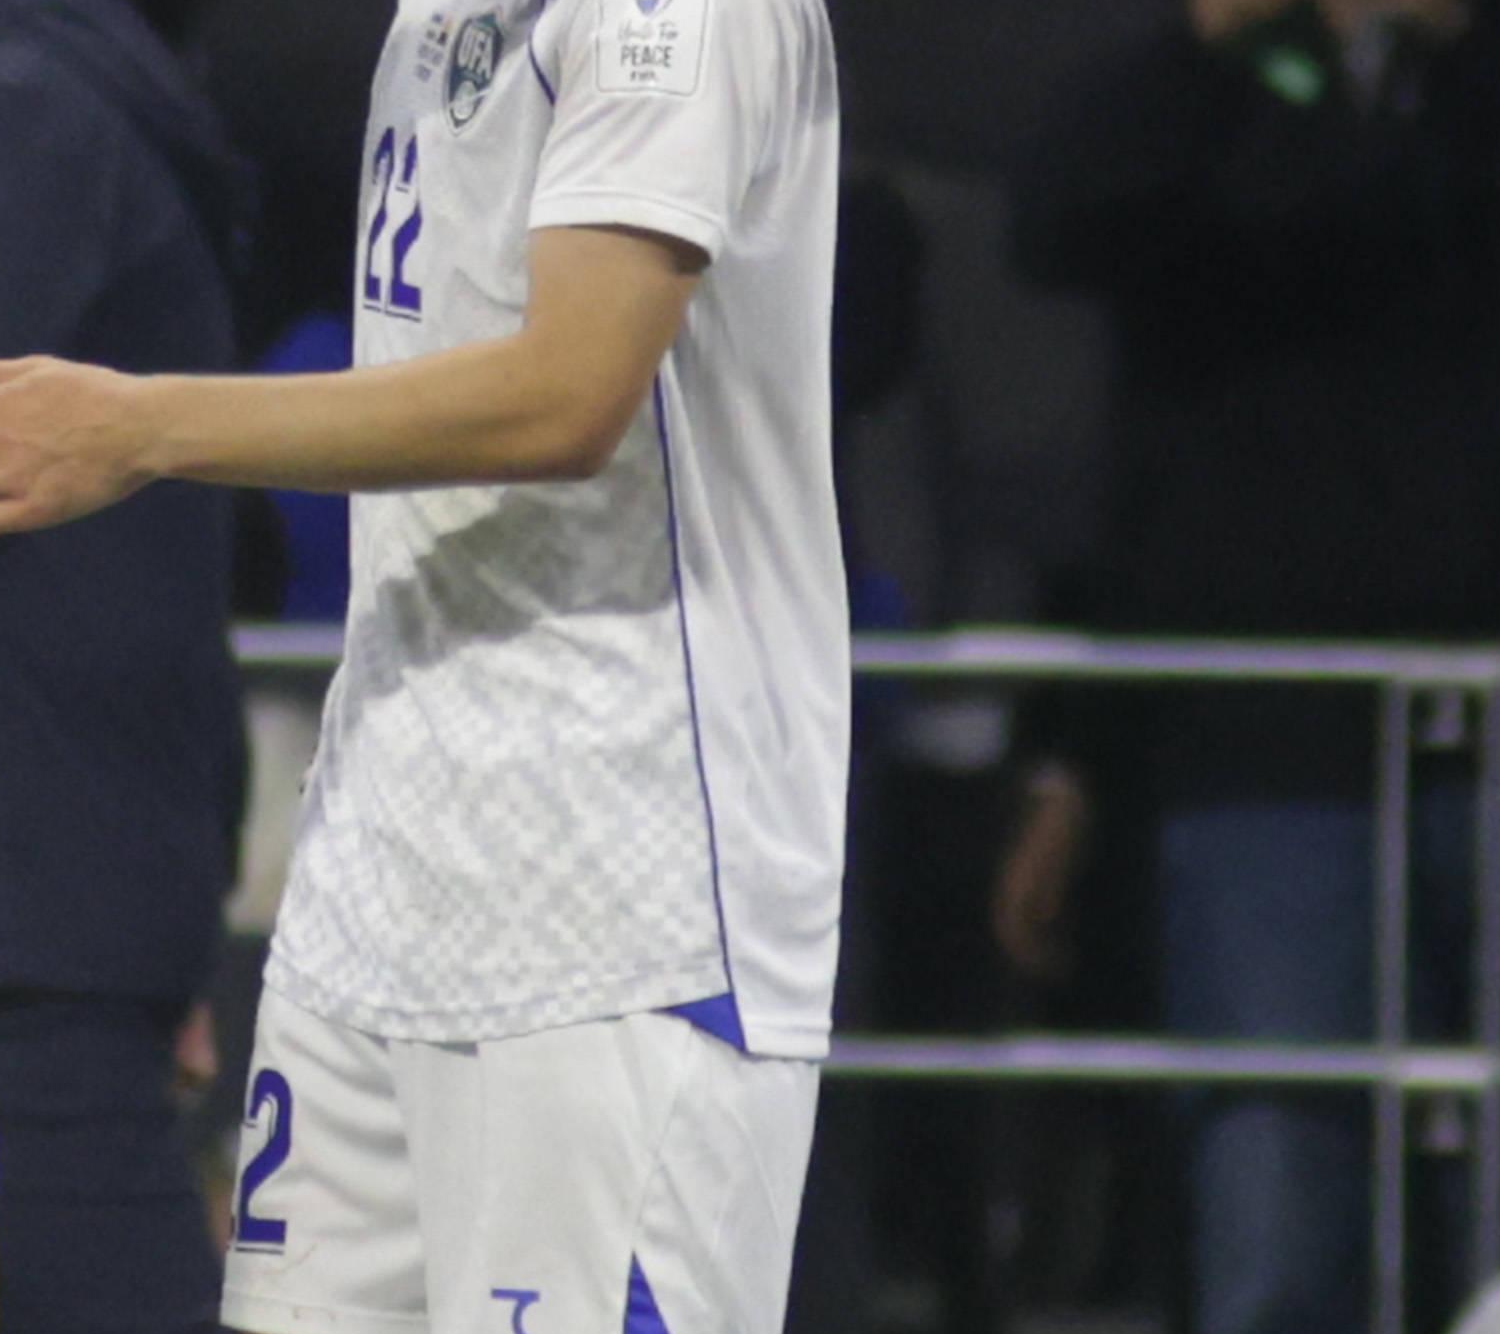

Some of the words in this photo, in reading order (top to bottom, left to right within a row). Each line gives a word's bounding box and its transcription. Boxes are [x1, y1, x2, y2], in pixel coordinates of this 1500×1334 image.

[620, 45, 673, 68] PEACE
[363, 126, 423, 323] 22
[229, 1068, 293, 1255] 2
